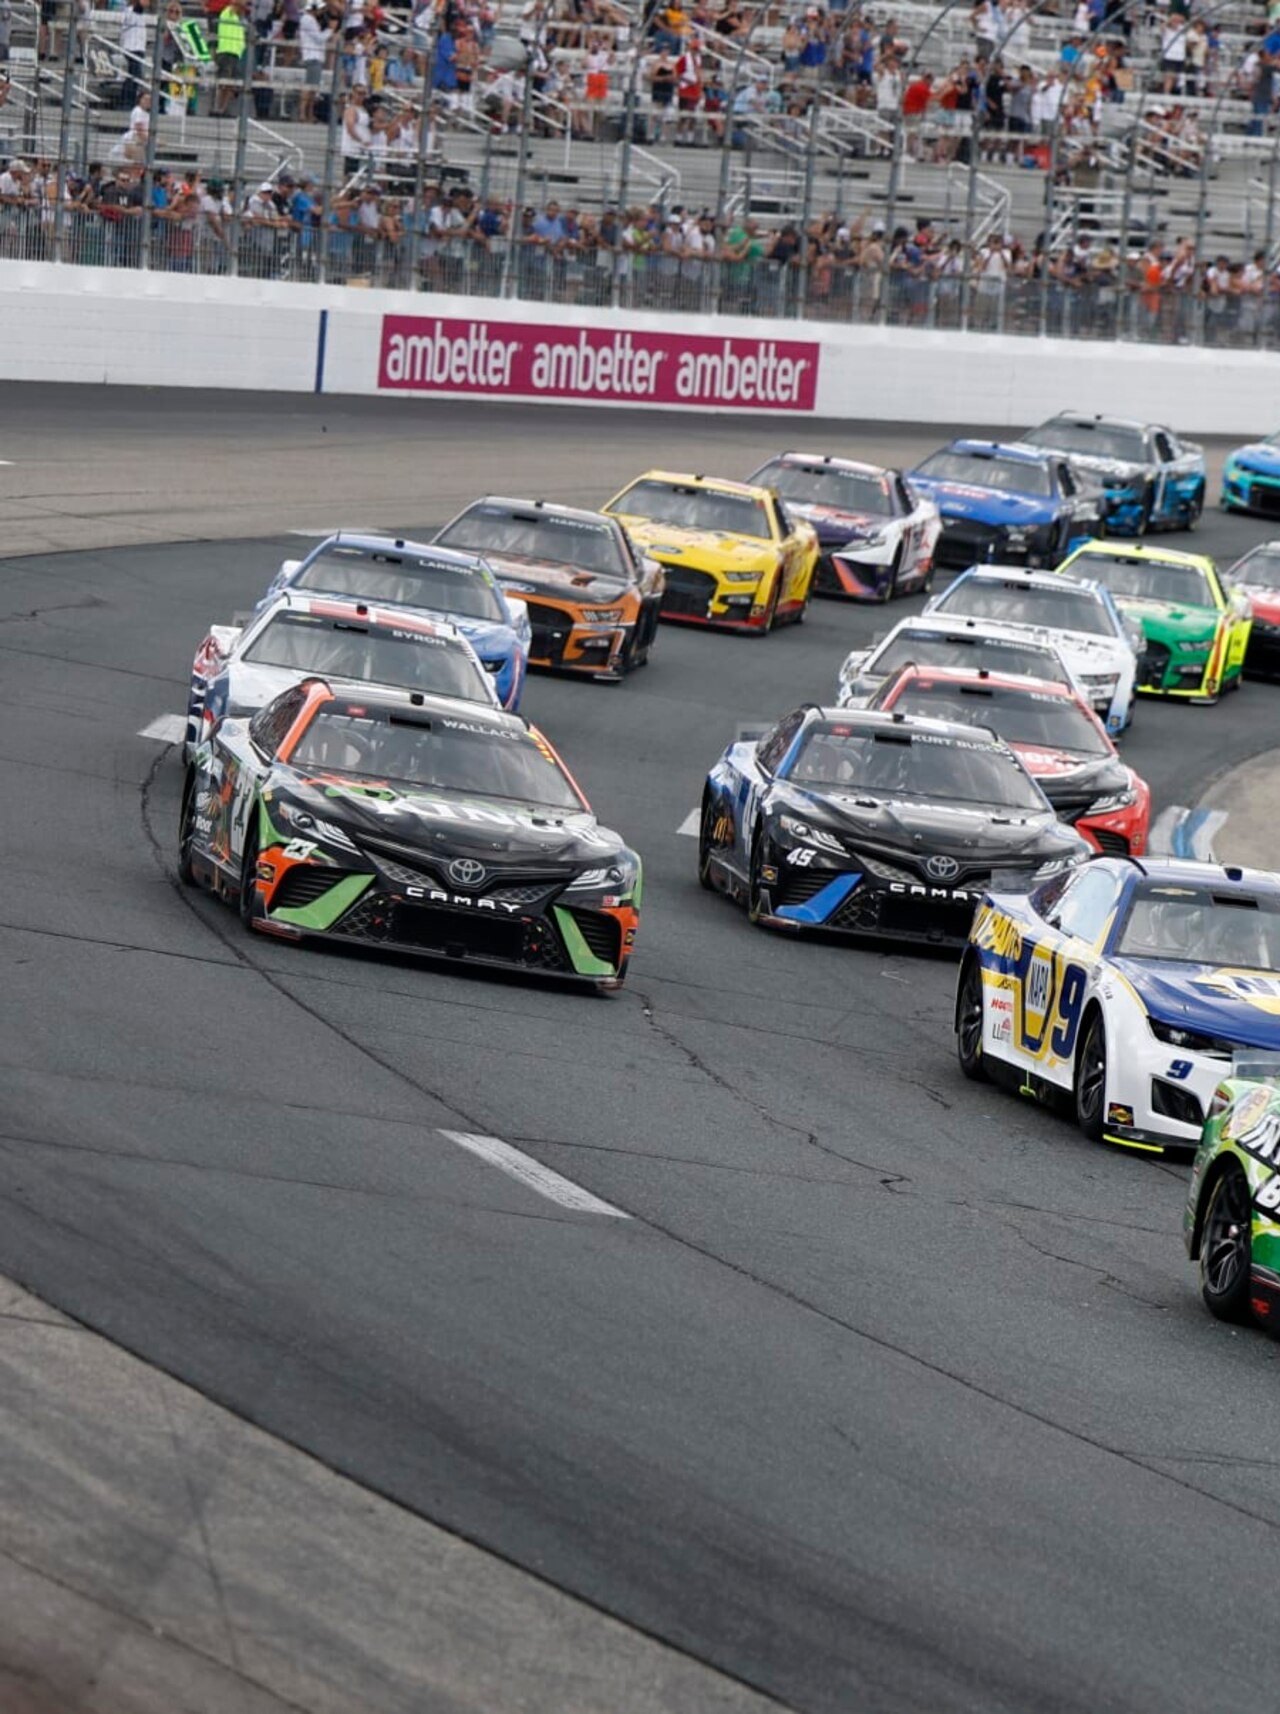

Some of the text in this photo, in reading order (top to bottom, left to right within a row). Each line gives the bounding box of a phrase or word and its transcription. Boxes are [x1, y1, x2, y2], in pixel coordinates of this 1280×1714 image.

[385, 320, 807, 403] ambetter ambetter ambetter
[418, 559, 474, 576] LARSON
[392, 629, 447, 647] BYRON
[443, 719, 521, 741] WALLACE
[911, 733, 953, 747] KURT
[282, 837, 320, 860] 23
[786, 847, 818, 868] 45
[406, 886, 522, 914] CAMRY
[1051, 963, 1088, 1059] 9
[1165, 1058, 1194, 1080] 9
